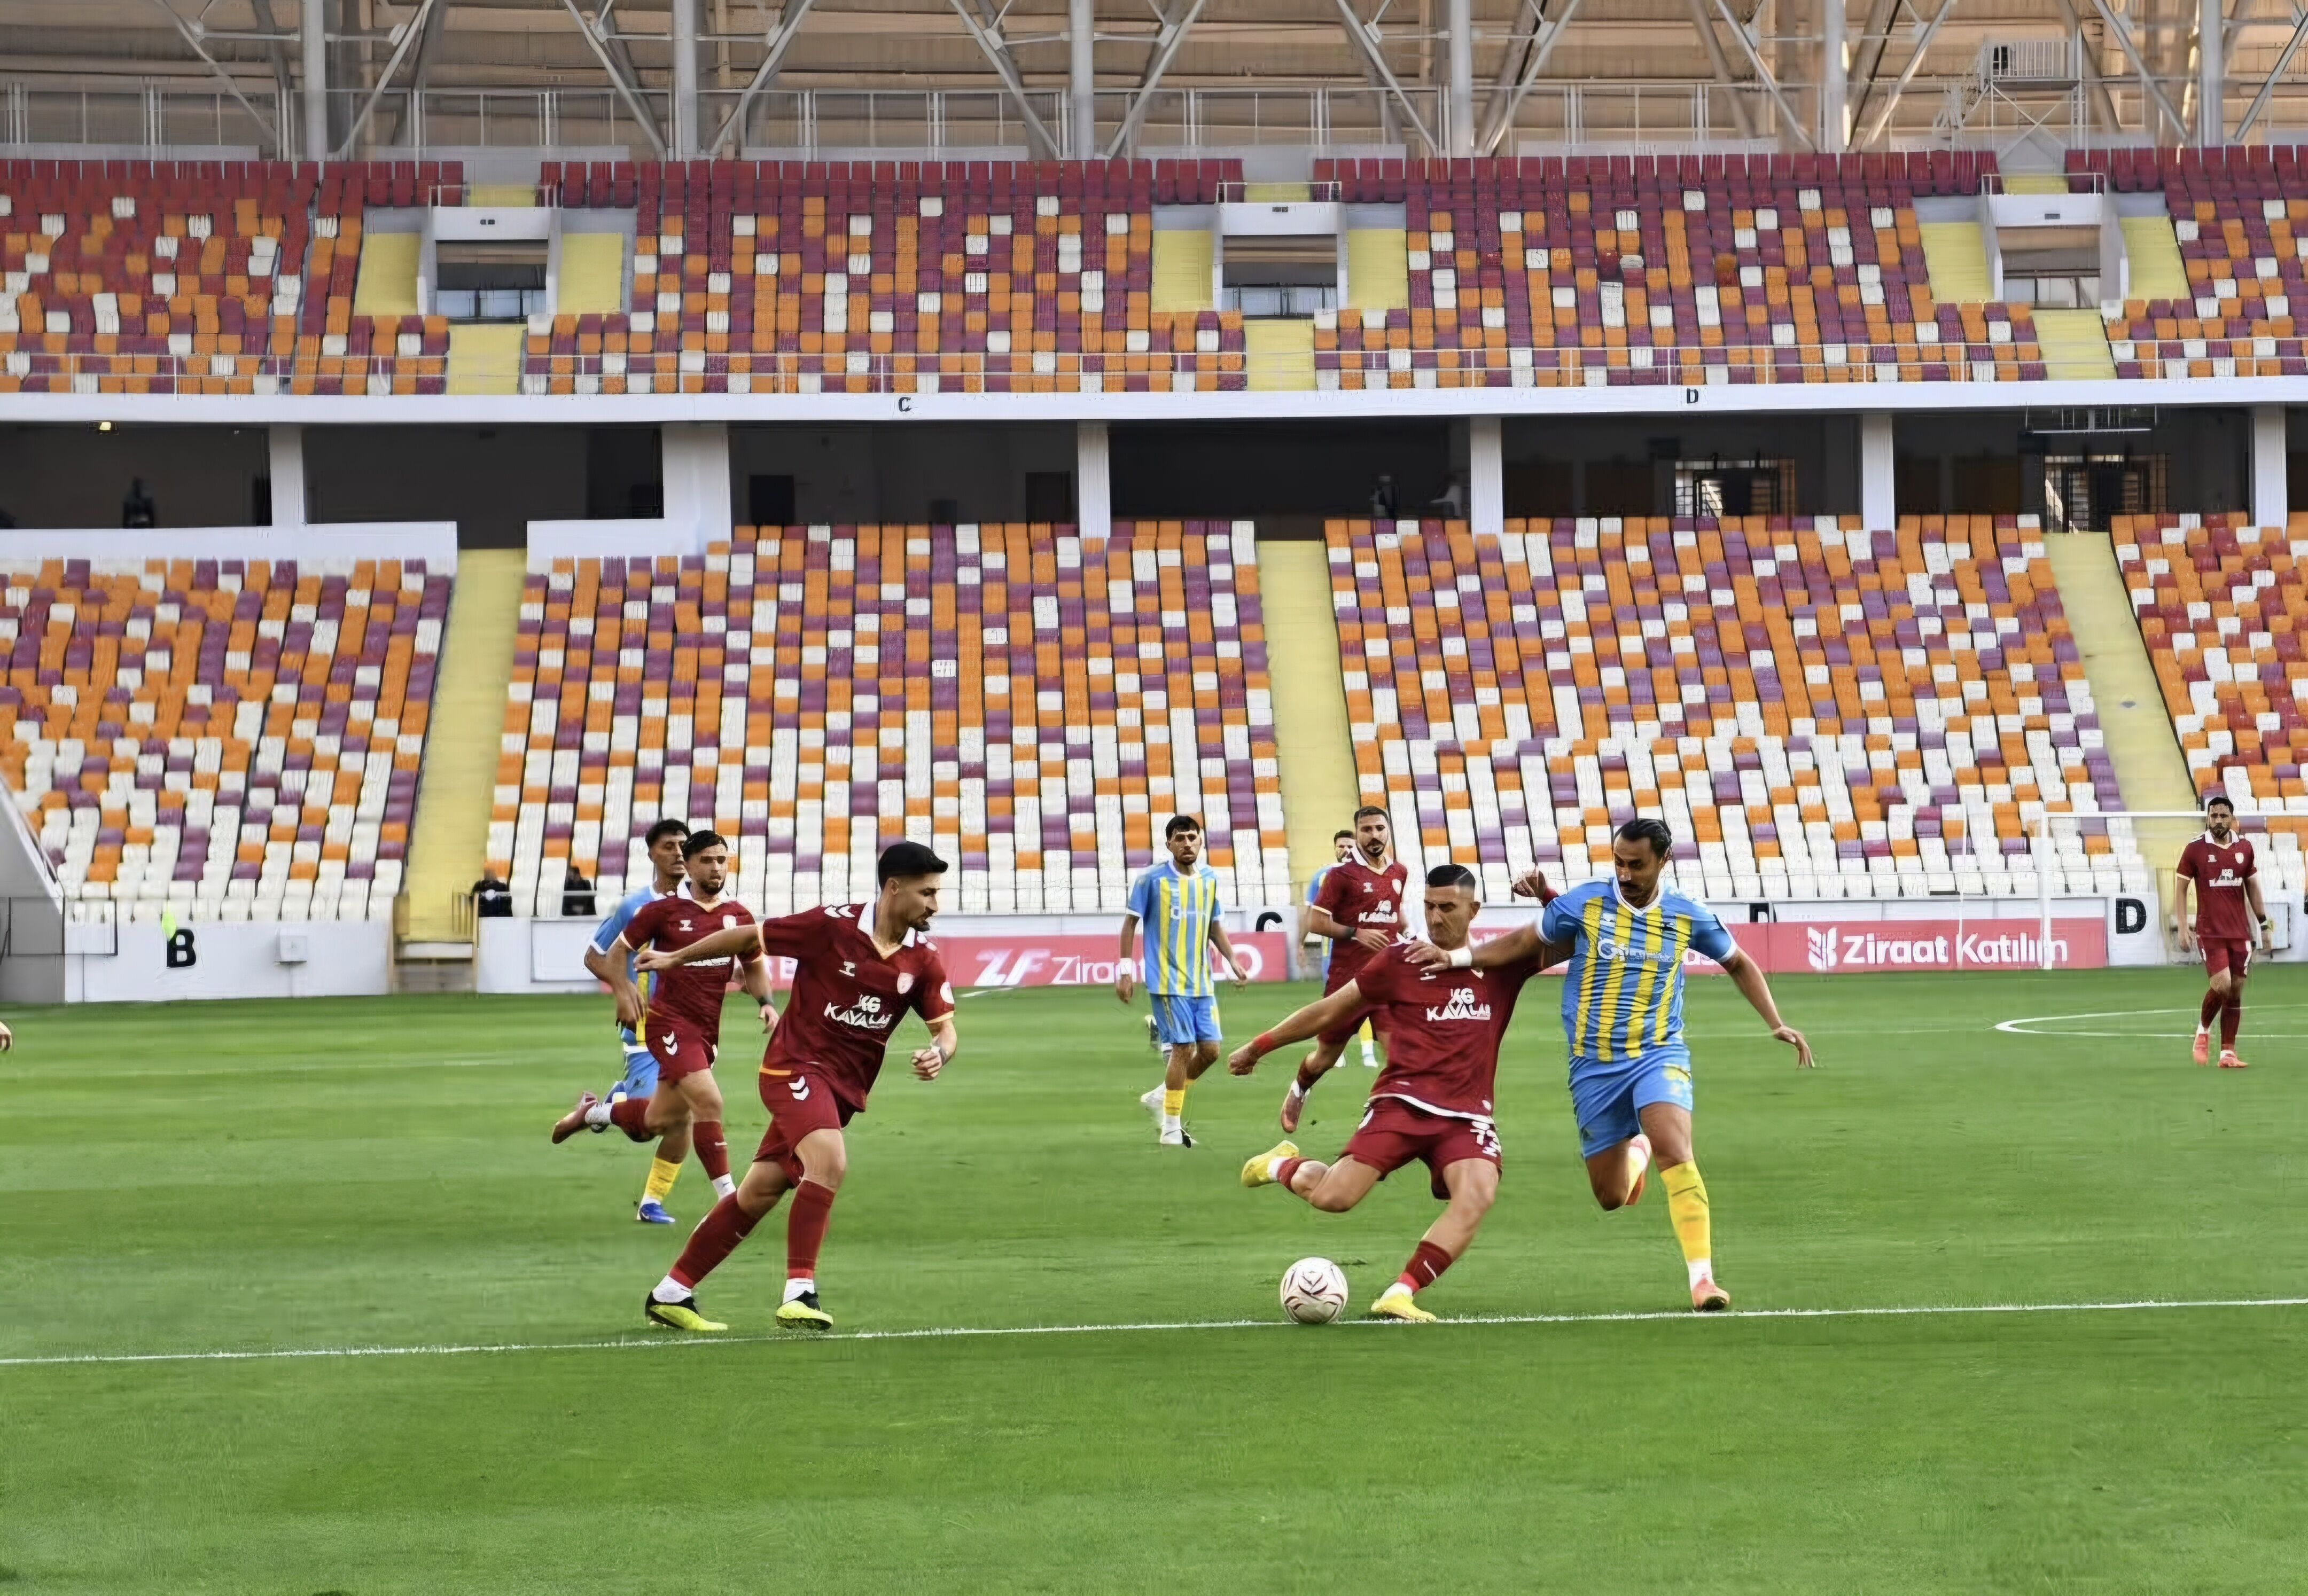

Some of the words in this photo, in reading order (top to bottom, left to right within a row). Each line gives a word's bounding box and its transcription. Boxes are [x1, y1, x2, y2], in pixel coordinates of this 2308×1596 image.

[898, 397, 911, 412] C
[1687, 388, 1699, 404] D
[2116, 898, 2147, 934] D
[166, 928, 196, 968] B
[1843, 933, 1948, 965] Ziraat
